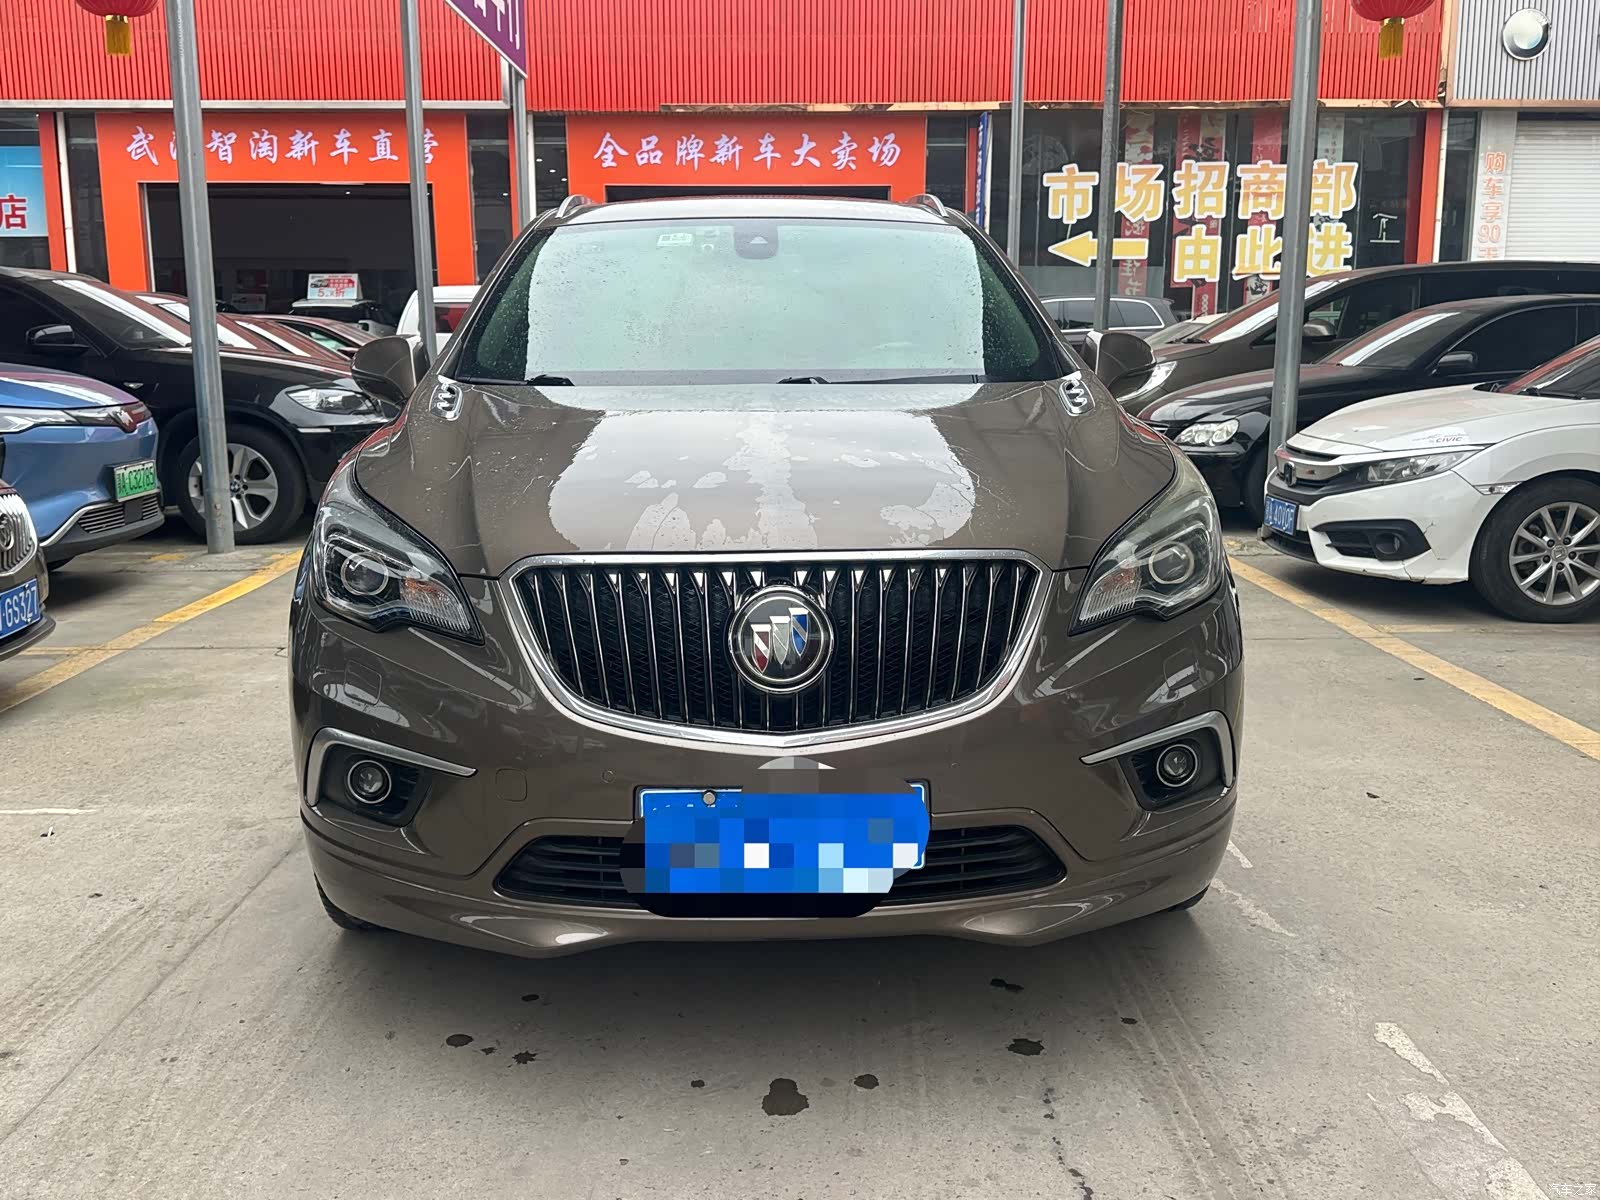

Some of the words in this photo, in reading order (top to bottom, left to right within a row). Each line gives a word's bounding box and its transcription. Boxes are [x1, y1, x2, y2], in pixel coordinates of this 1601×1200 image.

[125, 125, 440, 166] 武智淘新车直营
[593, 131, 903, 172] 全品牌新车大卖场
[0, 193, 28, 230] 店
[1043, 158, 1359, 224] 市场招商部
[1173, 222, 1354, 283] 由此进
